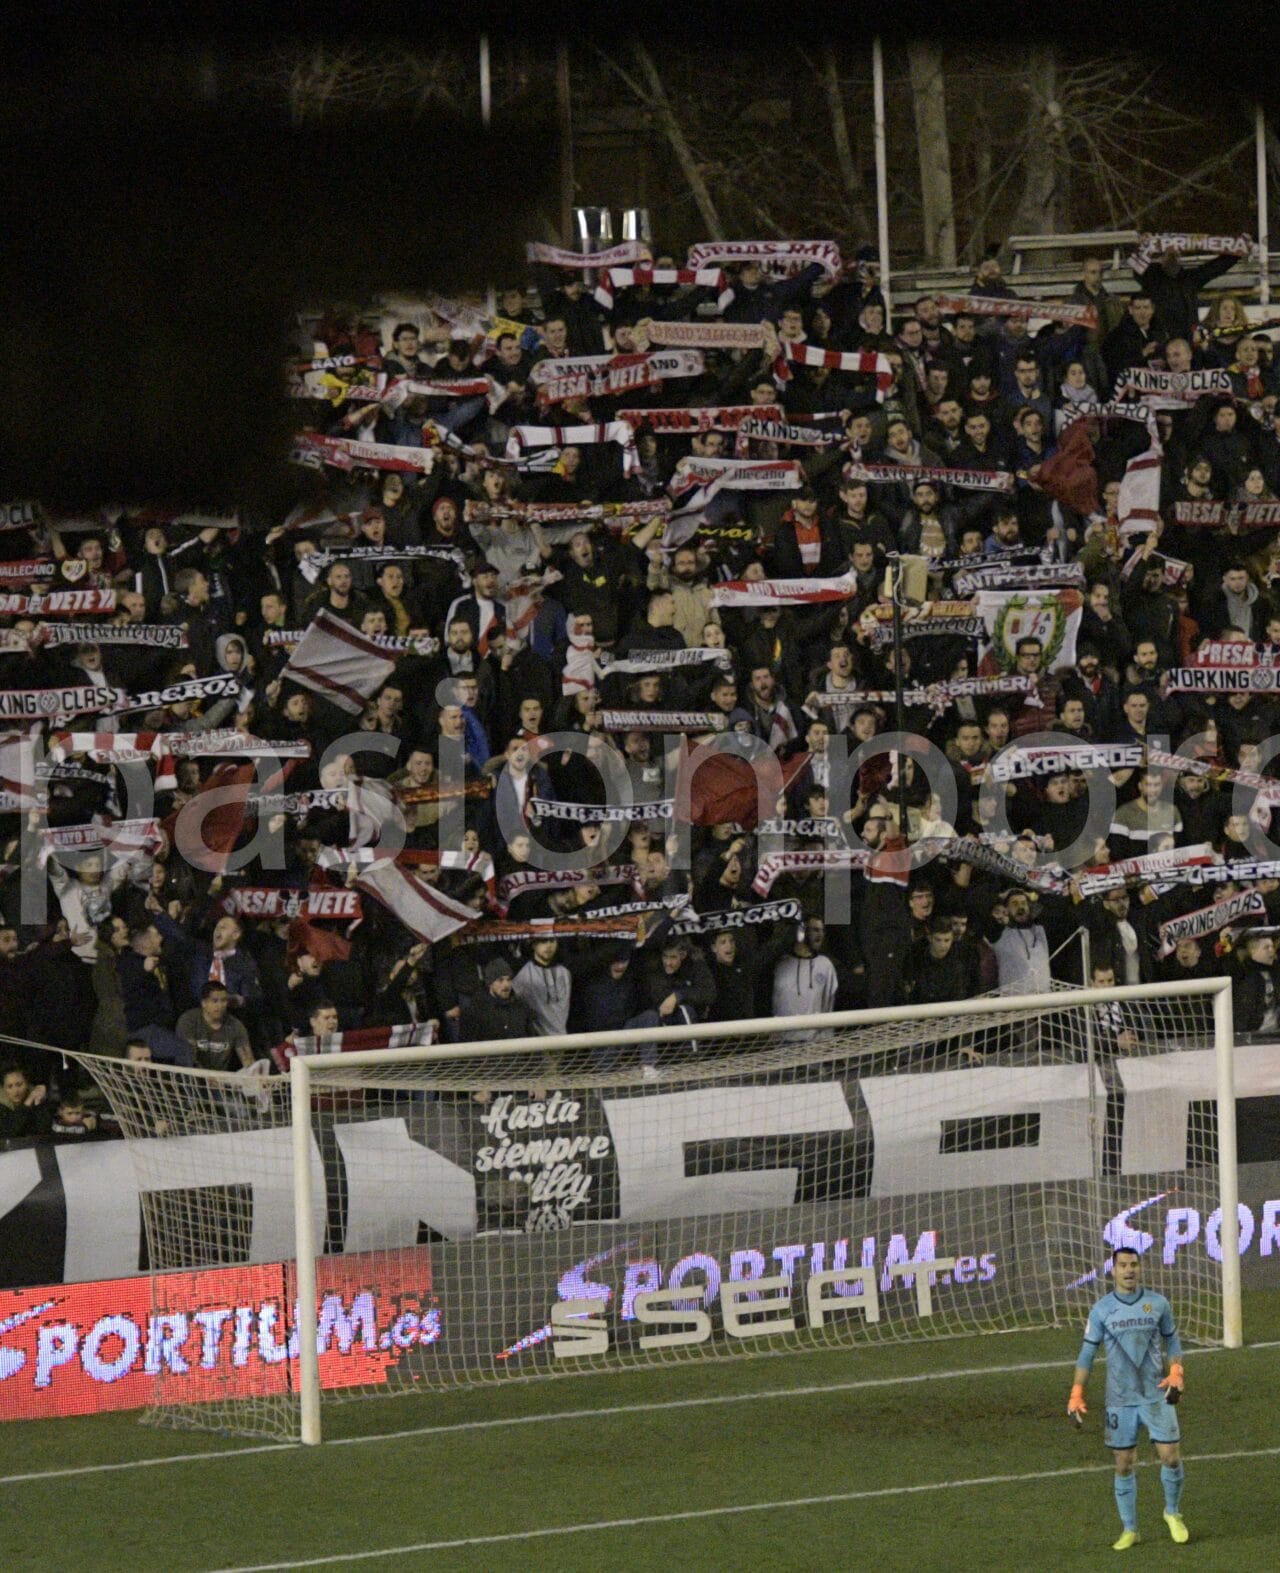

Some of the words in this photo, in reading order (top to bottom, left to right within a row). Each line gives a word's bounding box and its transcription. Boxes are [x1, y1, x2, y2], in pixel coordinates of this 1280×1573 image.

[1191, 371, 1231, 390] CLAS
[0, 563, 54, 577] ALLECANO
[48, 591, 97, 611] VETE
[1199, 642, 1251, 666] PRESA
[0, 693, 36, 714] KING
[60, 686, 119, 713] CLASS
[308, 889, 359, 914] VETE
[1228, 893, 1263, 919] CLAS
[480, 1091, 581, 1138] Hasta
[475, 1135, 610, 1172] siempre
[509, 1162, 592, 1210] illy
[633, 1256, 956, 1350] SEAT
[1111, 1317, 1155, 1329] PAMESA
